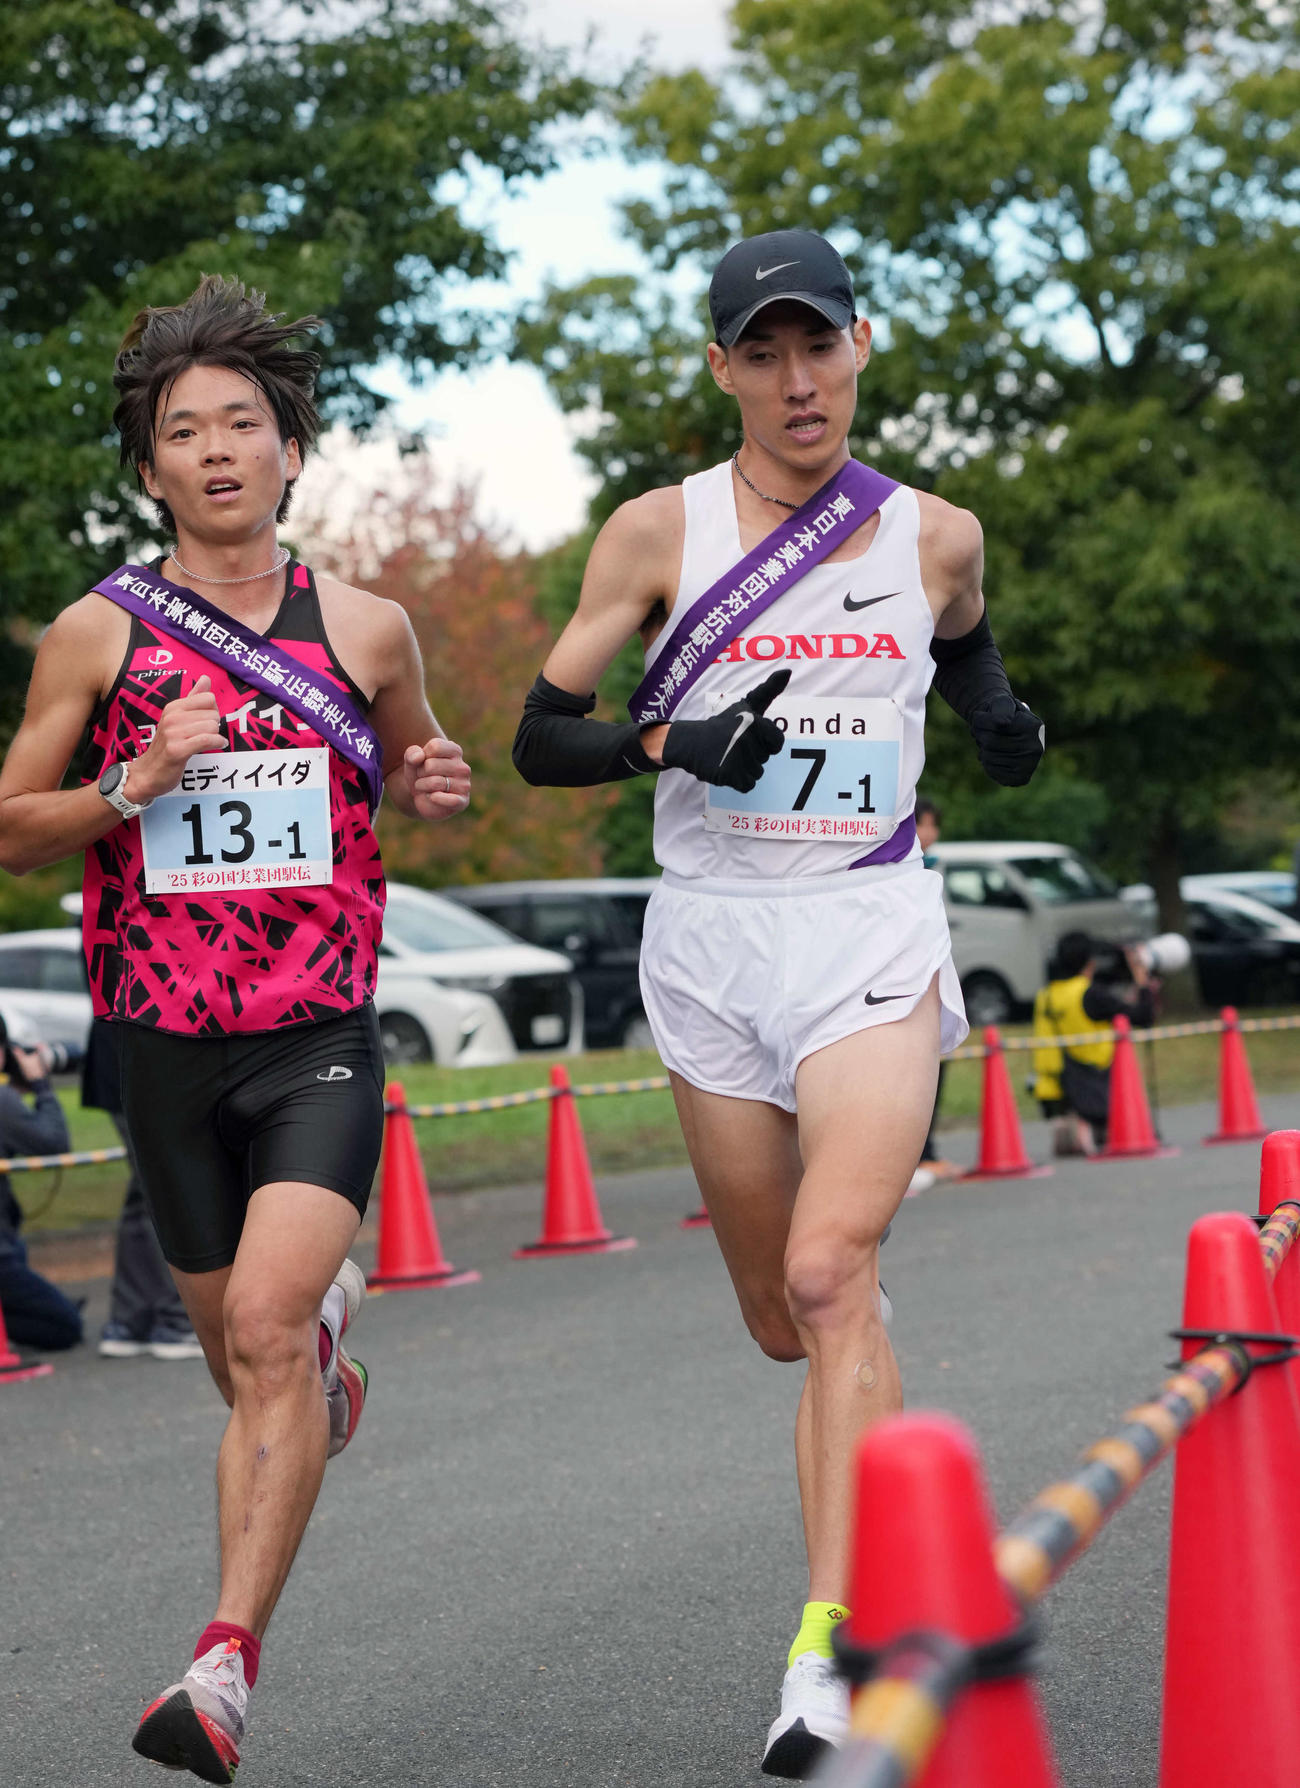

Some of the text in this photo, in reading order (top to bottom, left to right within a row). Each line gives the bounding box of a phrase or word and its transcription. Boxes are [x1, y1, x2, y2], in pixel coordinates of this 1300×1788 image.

[112, 572, 374, 760] 東日本実業団対抗駅伝競走大会
[137, 669, 187, 681] phiten
[774, 713, 866, 735] onda
[181, 760, 312, 791] モディイイダ
